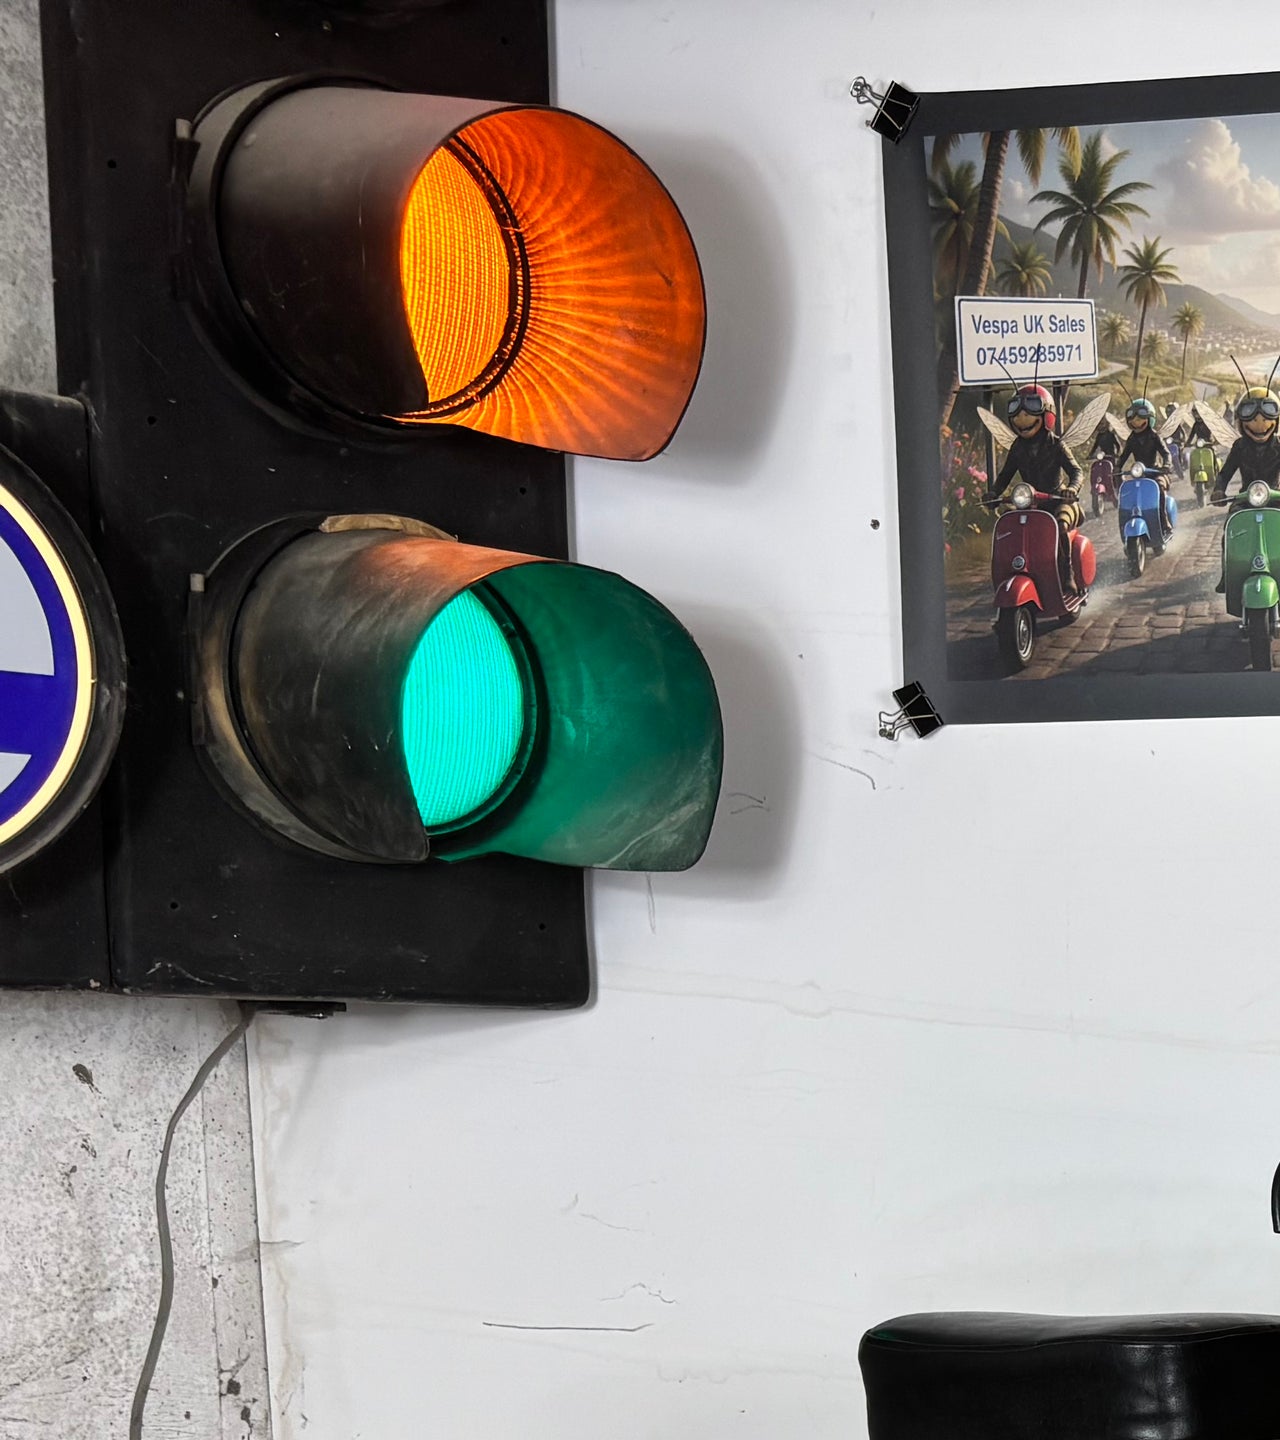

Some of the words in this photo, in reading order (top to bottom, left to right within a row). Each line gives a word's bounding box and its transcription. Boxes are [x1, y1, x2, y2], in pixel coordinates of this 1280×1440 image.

[971, 314, 1019, 339] Vespa
[1023, 314, 1045, 334] UK
[1048, 313, 1086, 334] Sales
[976, 344, 1082, 366] 07459285971
